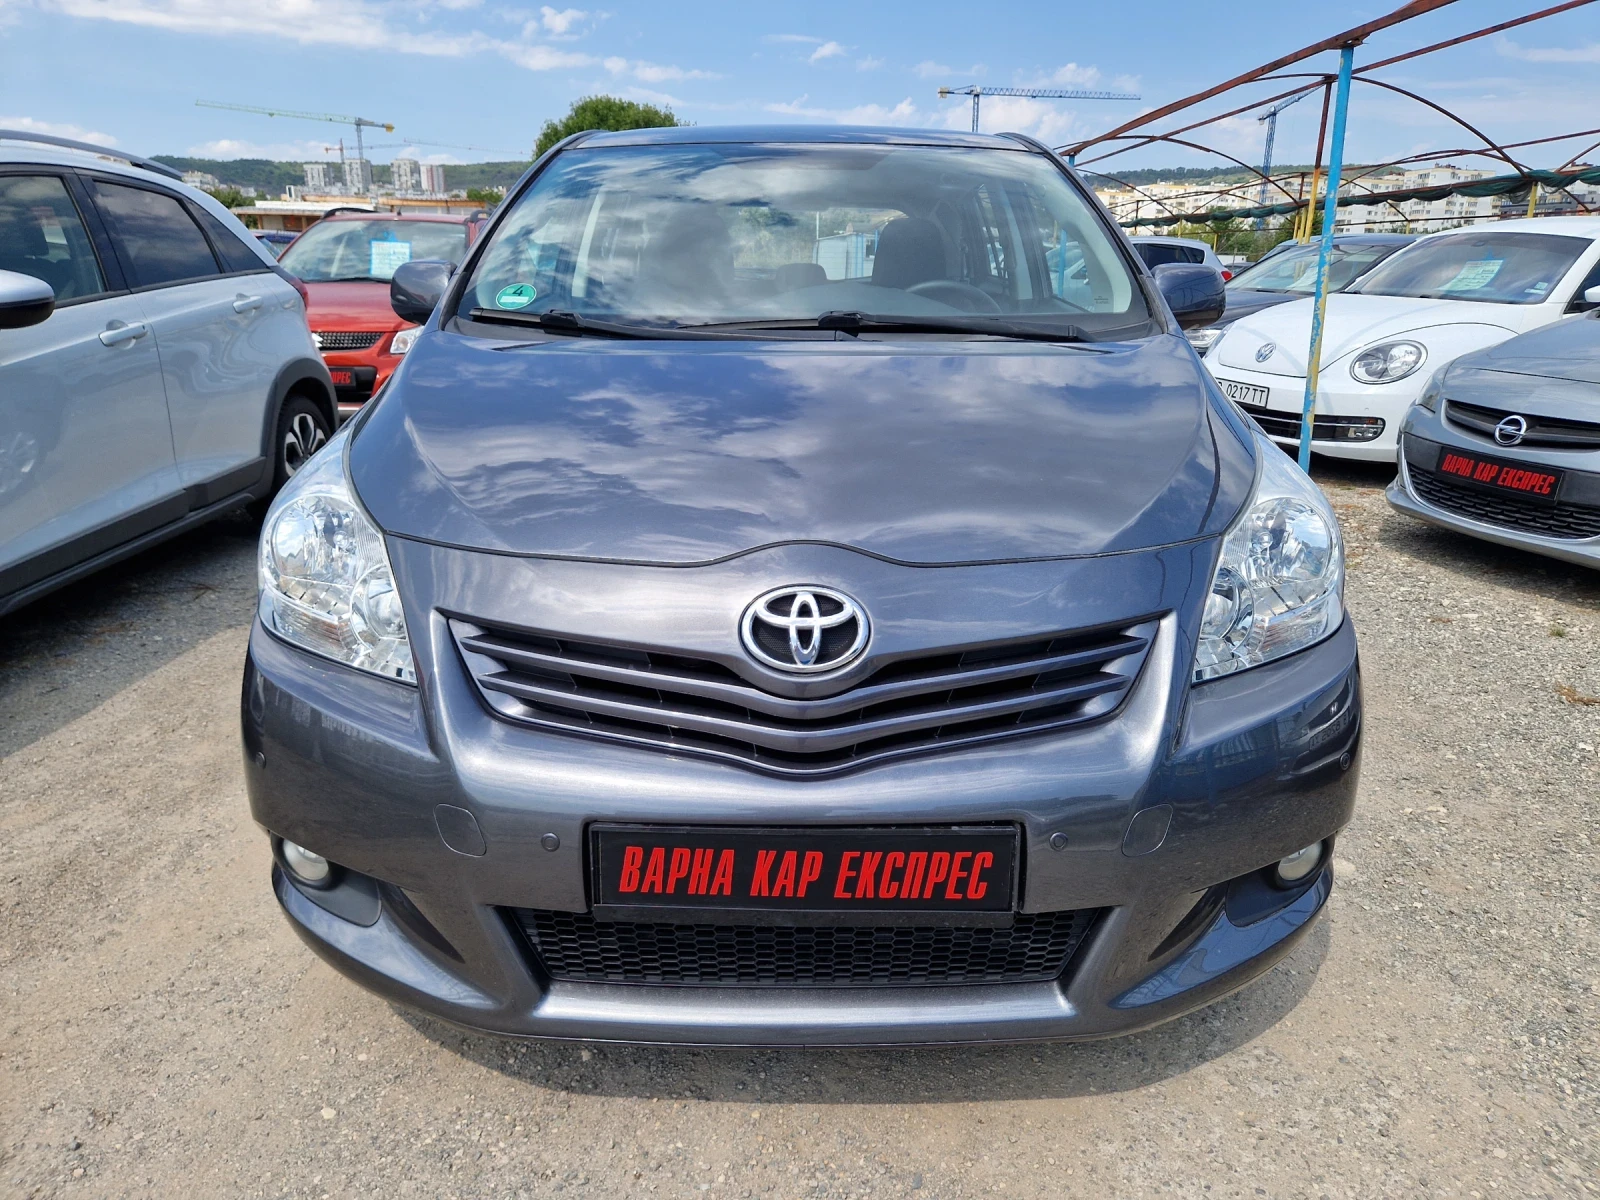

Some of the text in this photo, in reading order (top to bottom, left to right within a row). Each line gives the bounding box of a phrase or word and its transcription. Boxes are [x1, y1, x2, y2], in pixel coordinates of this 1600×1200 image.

[511, 285, 524, 296] 4
[330, 371, 351, 384] ПРЕС
[1226, 383, 1250, 401] 0217
[1441, 453, 1556, 495] ВАРНА КАР ЕКСПРЕС
[618, 846, 994, 899] ВАРНА КАР ЕКСПРЕС
